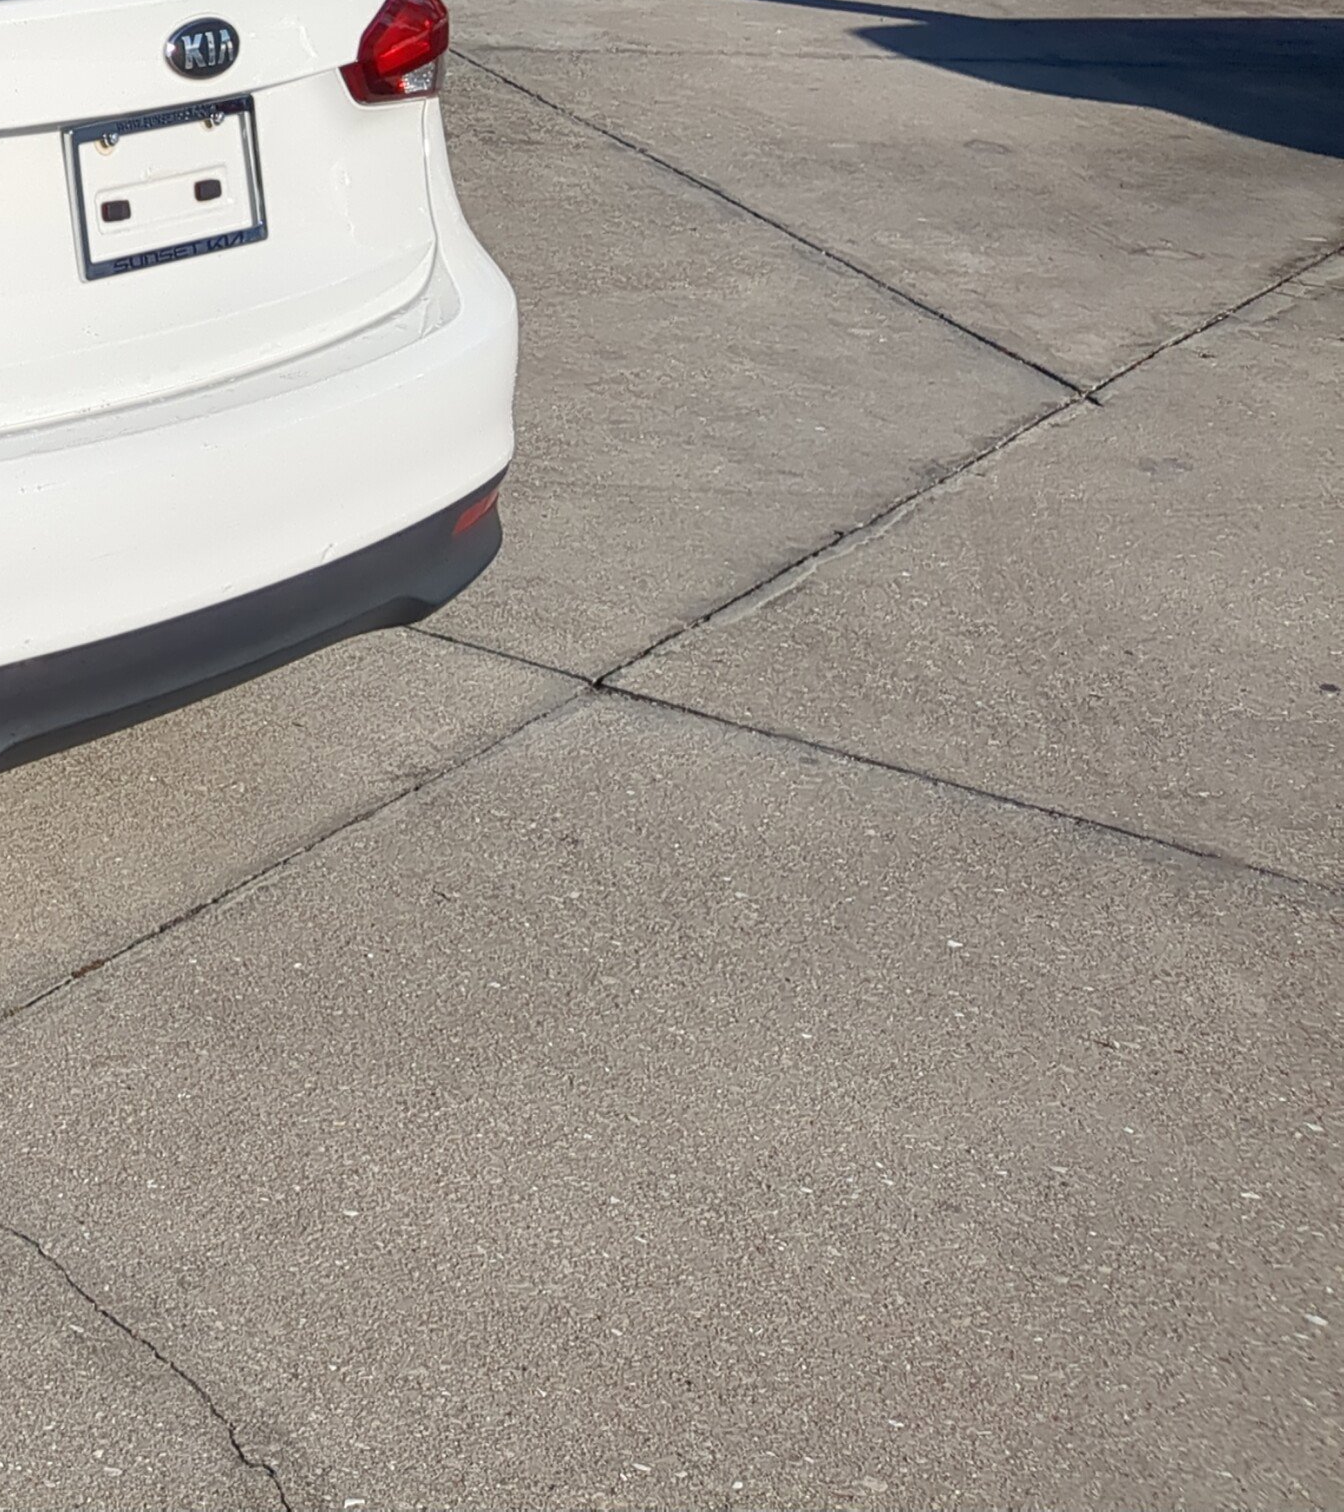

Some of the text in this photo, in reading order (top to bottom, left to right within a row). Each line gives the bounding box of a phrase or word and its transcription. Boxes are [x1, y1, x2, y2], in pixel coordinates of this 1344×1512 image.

[181, 29, 233, 69] KIA
[112, 230, 244, 273] SUNSET KIA
